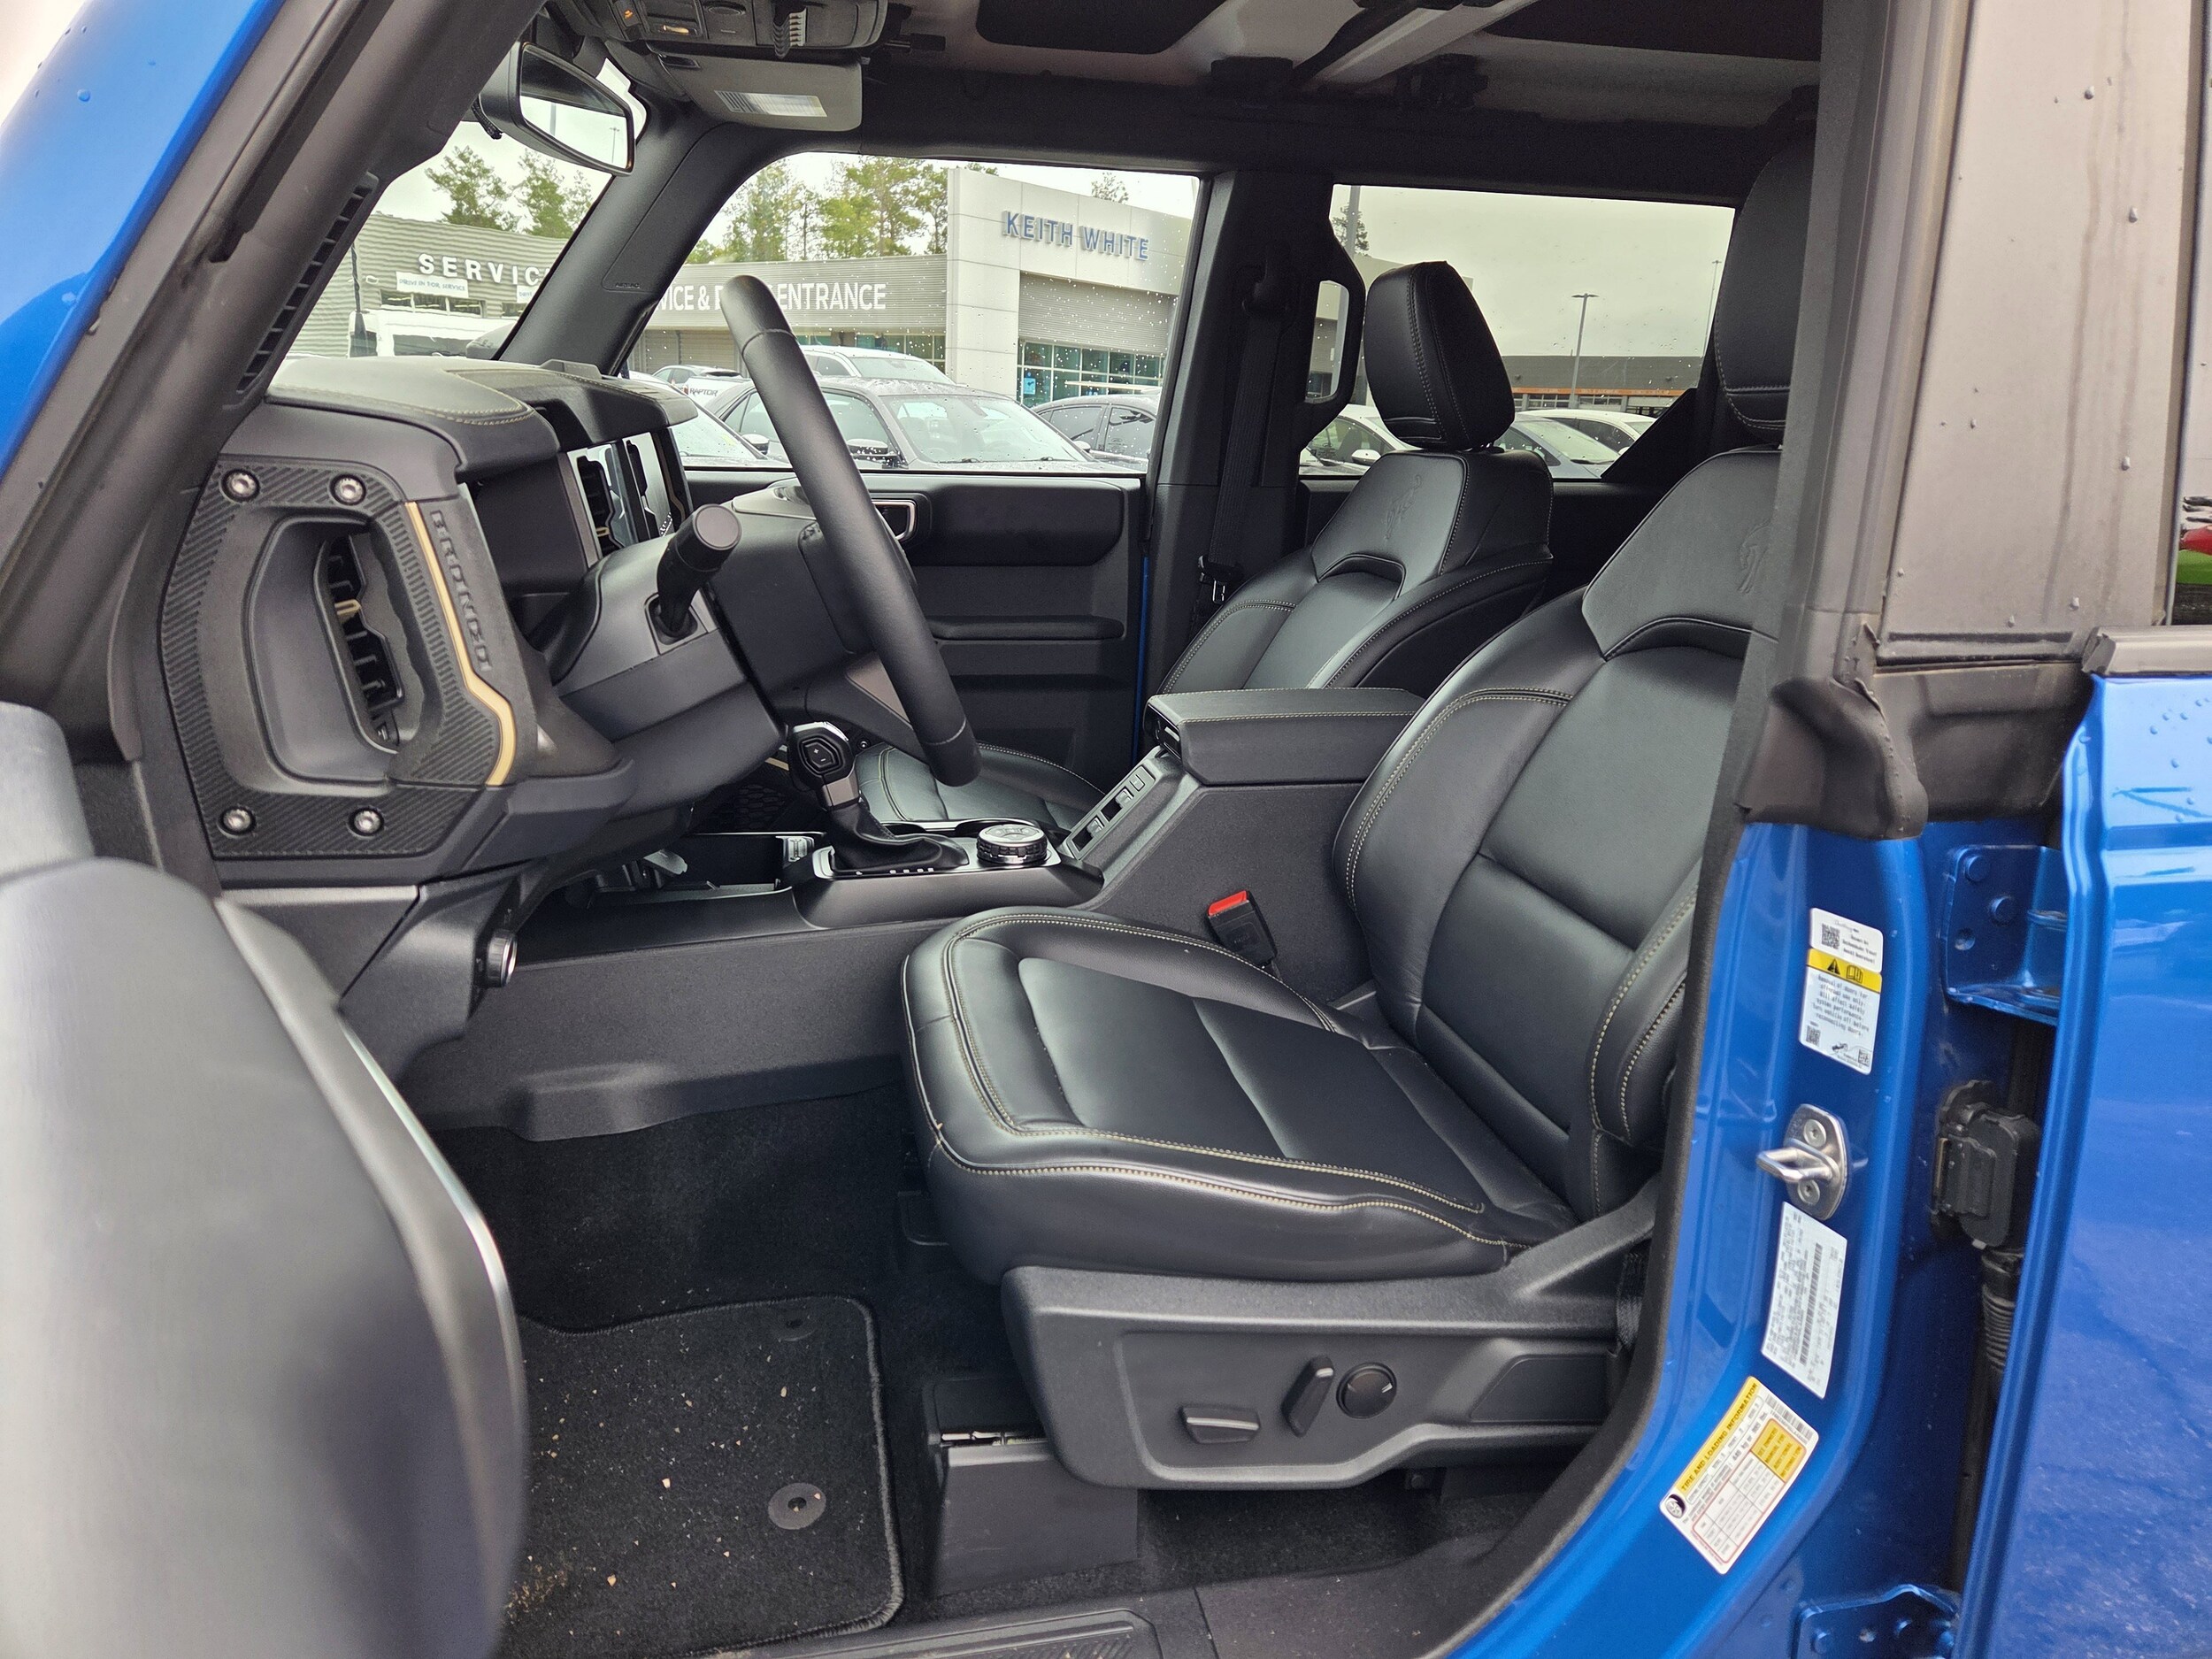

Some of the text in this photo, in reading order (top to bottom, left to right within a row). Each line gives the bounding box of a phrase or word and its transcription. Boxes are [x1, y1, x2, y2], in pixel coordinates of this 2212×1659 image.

[1004, 211, 1149, 260] KEITH WHITE
[418, 253, 550, 287] SERVIC
[697, 284, 710, 311] &
[777, 282, 886, 311] ENTRANCE
[689, 388, 718, 396] RAPTOR
[1681, 1474, 1695, 1491] TIRE
[1694, 1460, 1706, 1476] AND
[1704, 1430, 1727, 1461] LOADING
[1726, 1383, 1758, 1431] INFORMATION
